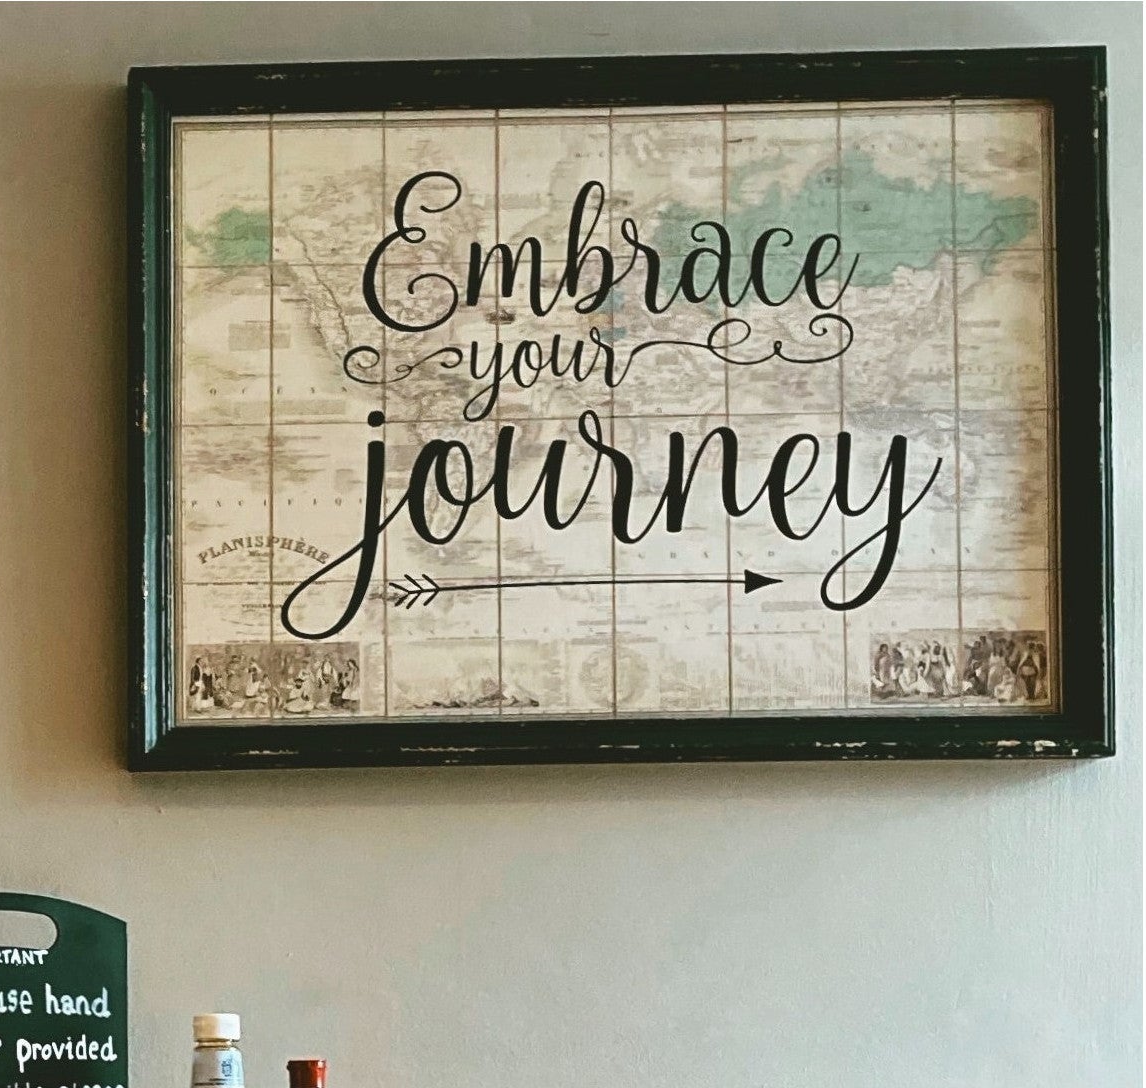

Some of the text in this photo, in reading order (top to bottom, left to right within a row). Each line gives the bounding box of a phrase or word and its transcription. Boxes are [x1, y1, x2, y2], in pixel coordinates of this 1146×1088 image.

[362, 170, 860, 333] Embrace
[462, 327, 640, 423] your
[198, 535, 330, 565] PLANISPHÈRE
[280, 410, 943, 640] journey
[45, 982, 111, 1019] hand
[16, 1033, 118, 1073] provided
